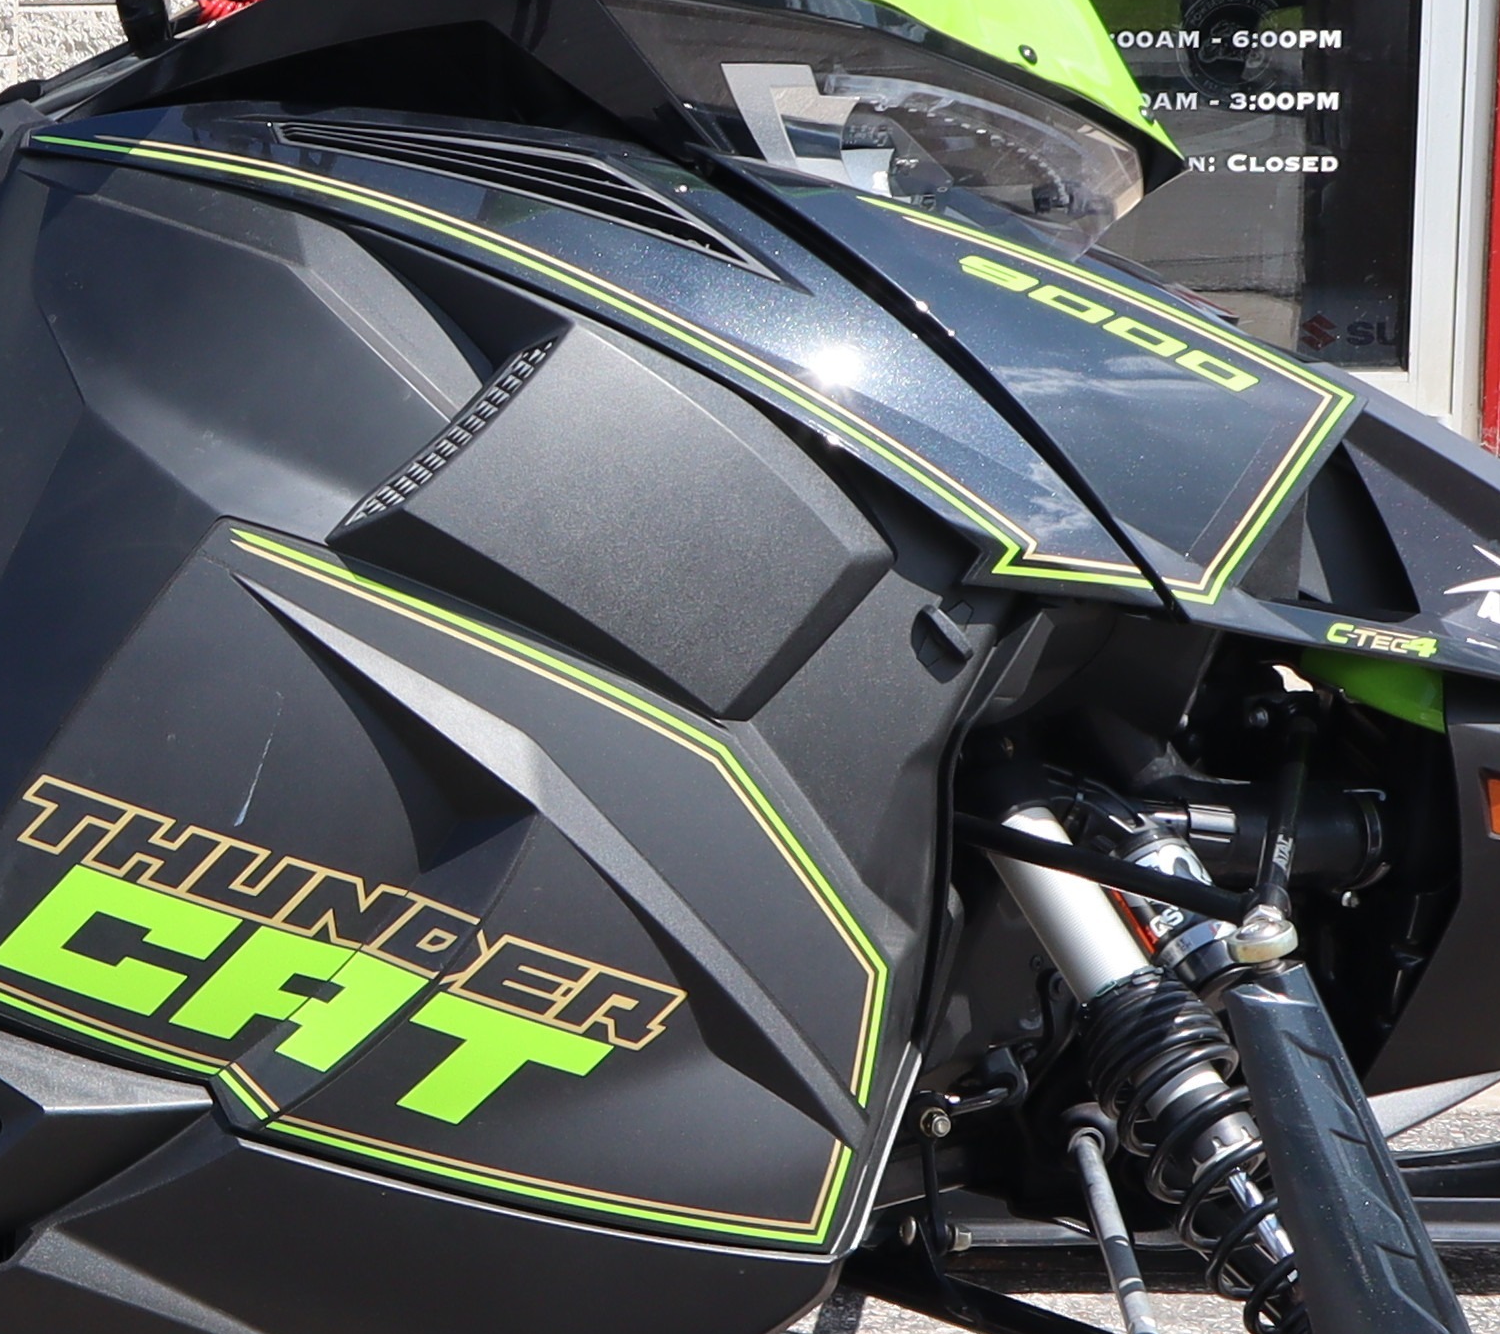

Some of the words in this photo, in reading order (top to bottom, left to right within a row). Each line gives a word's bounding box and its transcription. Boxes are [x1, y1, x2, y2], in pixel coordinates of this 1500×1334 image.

[1110, 30, 1200, 49] :00AM
[1232, 30, 1342, 49] 6:00PM
[1229, 92, 1340, 111] 3:00PM
[1188, 155, 1215, 172] N:
[16, 774, 687, 1052] THUNDER
